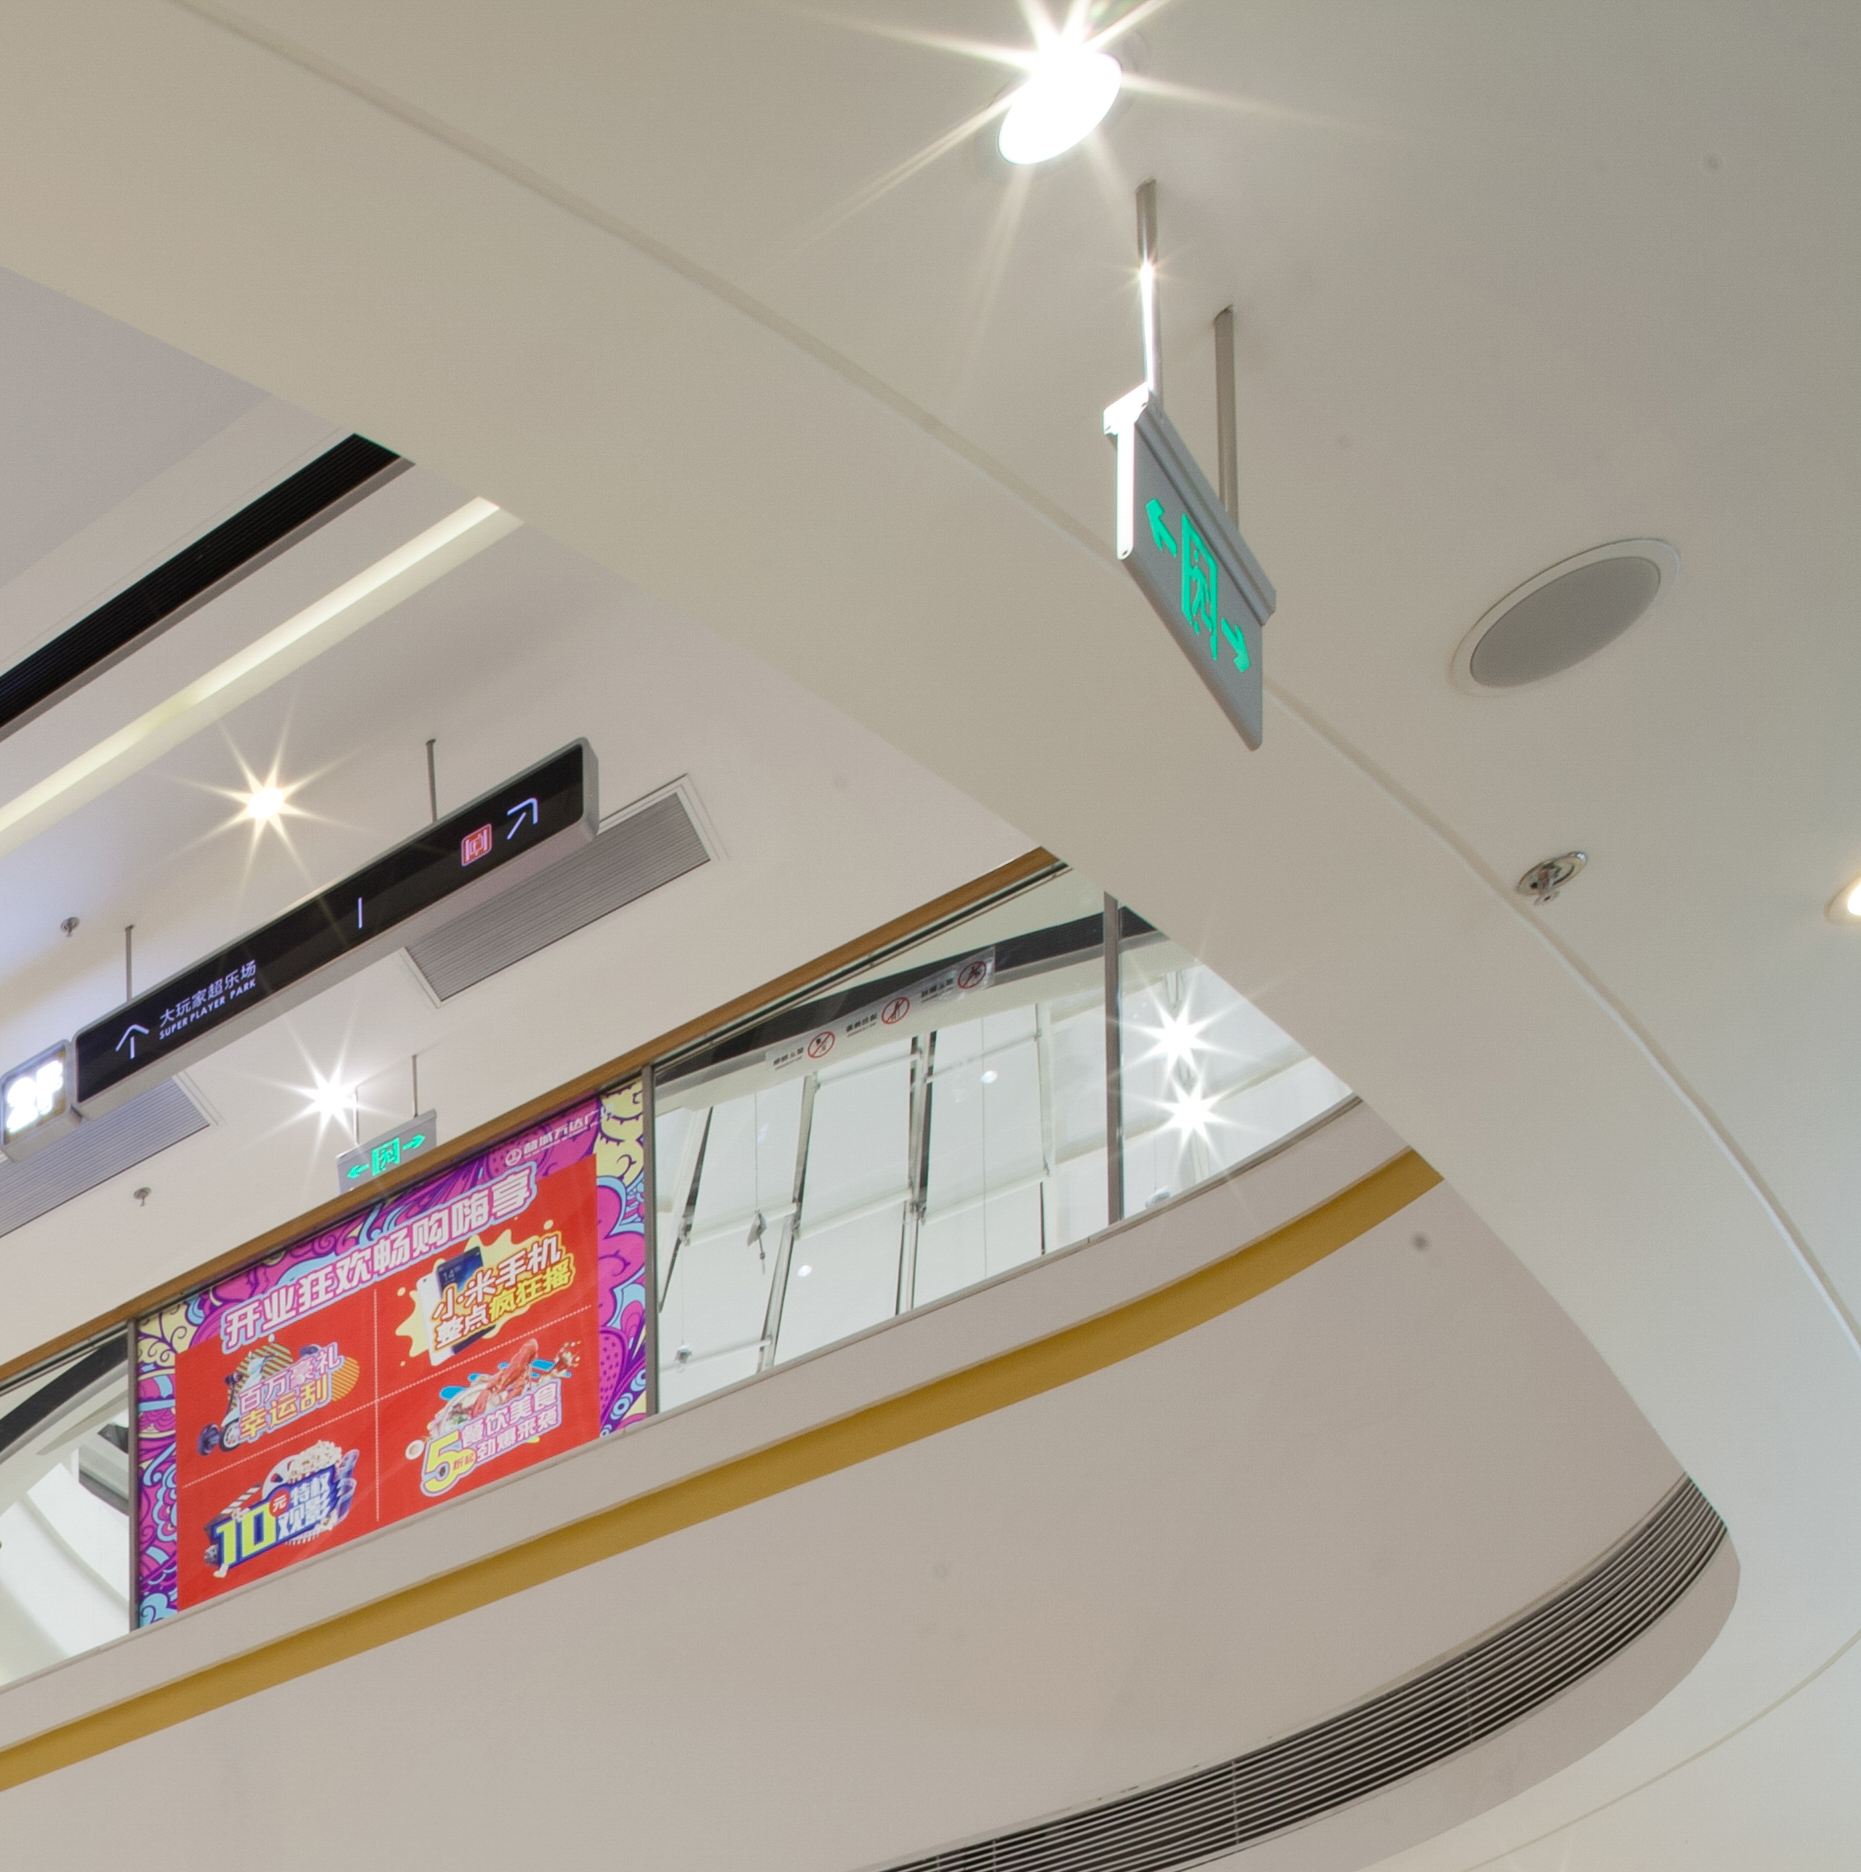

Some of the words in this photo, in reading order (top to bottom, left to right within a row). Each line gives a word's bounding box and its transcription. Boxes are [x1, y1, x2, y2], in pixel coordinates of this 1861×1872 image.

[159, 960, 256, 1028] 大玩家超乐场
[159, 1019, 188, 1040] SUPER
[190, 999, 225, 1023] PLAYER
[230, 979, 256, 1000] PARK
[227, 1168, 530, 1347] 开业狂欢畅购嗨享
[433, 1235, 562, 1321] 小米手机
[436, 1261, 570, 1349] 整点疯狂摇
[239, 1347, 340, 1413] 百万豪礼
[239, 1376, 328, 1440] 幸运刮
[461, 1383, 557, 1447] 餐饮美食
[278, 1499, 330, 1540] 观影
